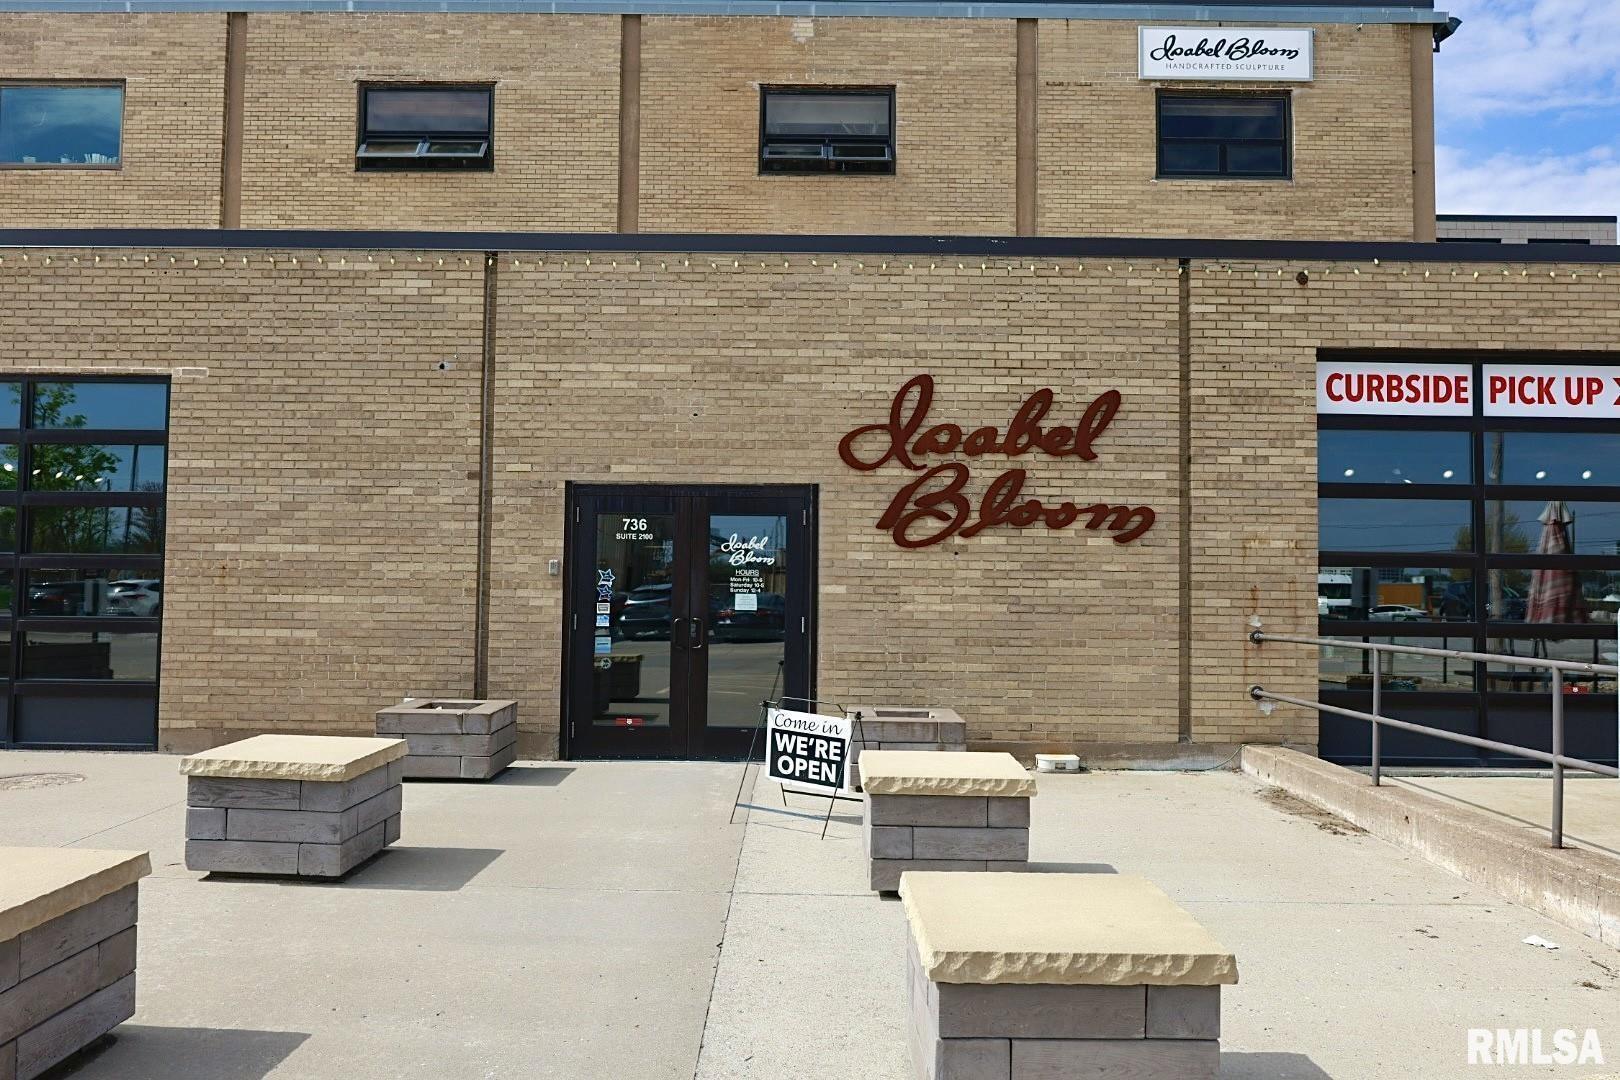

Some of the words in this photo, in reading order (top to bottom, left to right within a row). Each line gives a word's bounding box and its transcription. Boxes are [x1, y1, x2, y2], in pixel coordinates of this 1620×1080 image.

[1150, 34, 1227, 61] Isabel
[1225, 37, 1299, 61] Bloom
[1325, 373, 1469, 404] CURBSIDE
[1490, 375, 1556, 405] PICK
[1564, 377, 1604, 405] UP
[838, 374, 1122, 470] Isabel
[875, 462, 1156, 548] Bloom
[615, 532, 637, 540] SUITE
[622, 518, 648, 531] 736
[721, 533, 769, 552] Isabel
[729, 549, 775, 566] Bloom
[735, 569, 760, 577] HOURS
[774, 713, 820, 732] Come
[822, 720, 843, 735] in
[775, 732, 842, 761] WE'RE
[777, 755, 837, 783] OPEN
